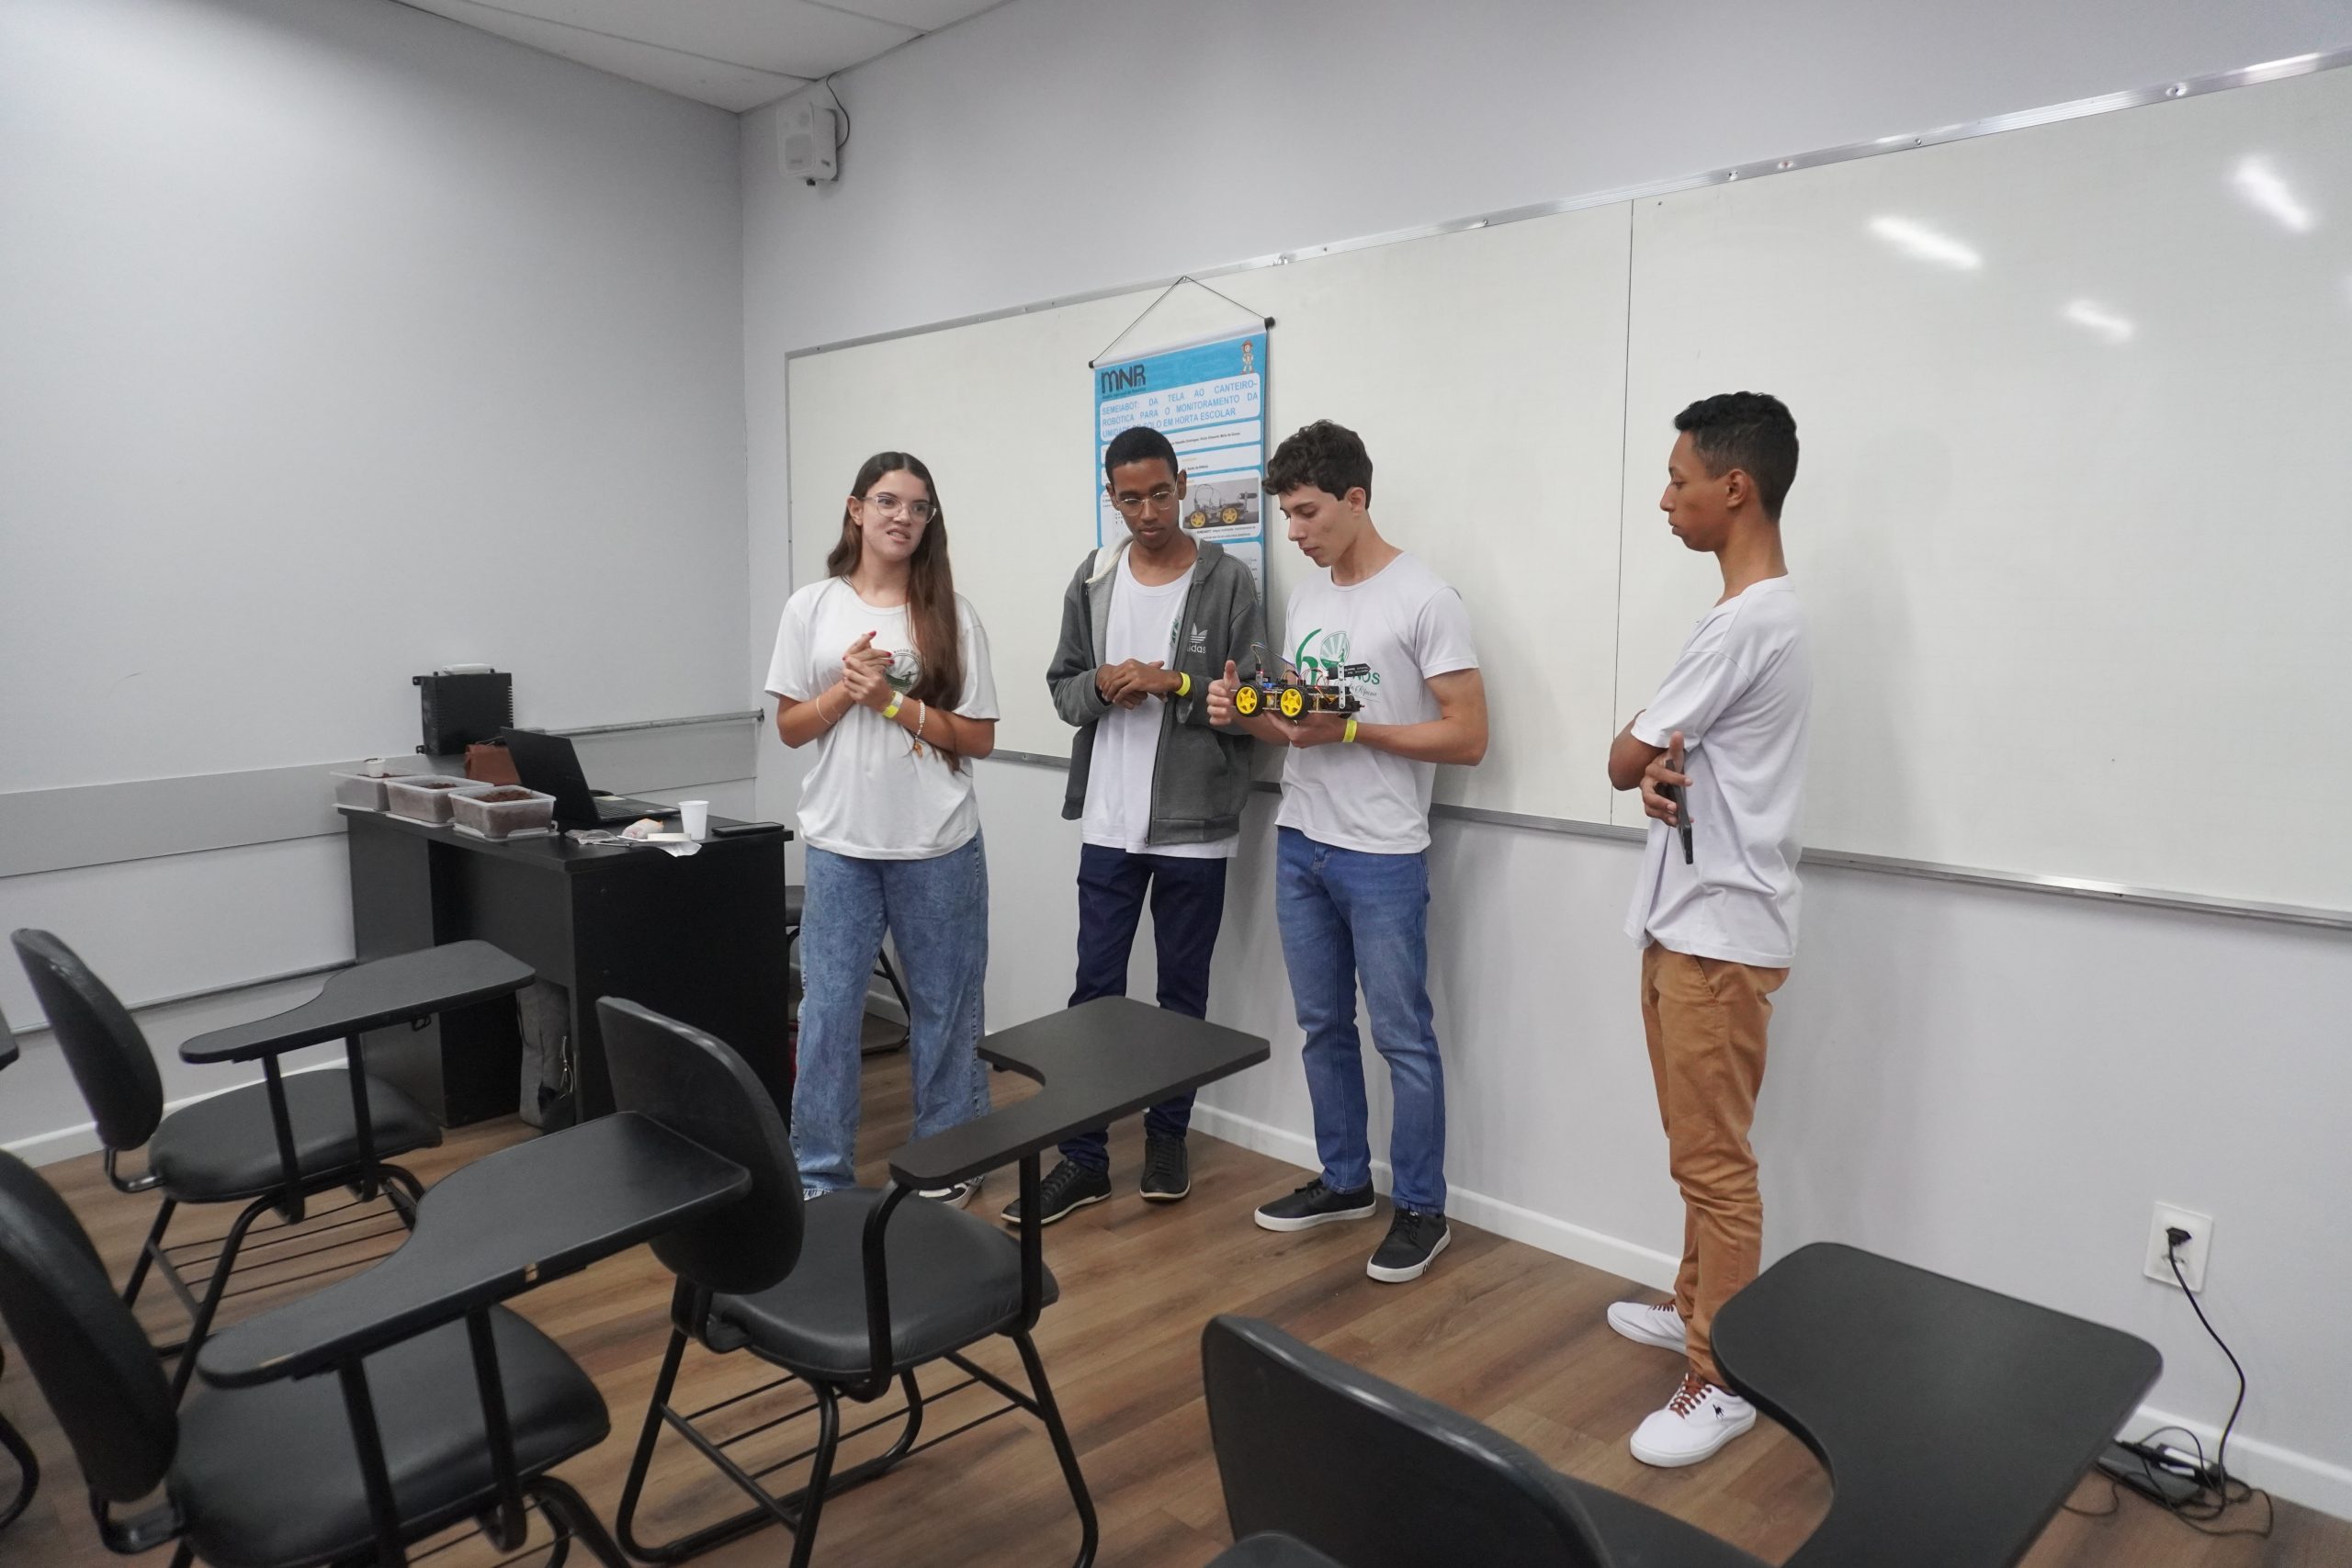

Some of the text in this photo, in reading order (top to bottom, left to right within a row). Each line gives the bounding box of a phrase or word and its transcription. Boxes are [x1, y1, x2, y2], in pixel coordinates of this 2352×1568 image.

[1148, 397, 1159, 406] DA
[1168, 392, 1185, 403] TELA
[1193, 388, 1204, 398] AO
[1214, 379, 1258, 394] CANTEIRO-
[1102, 413, 1135, 427] ROBÓTICA
[1139, 410, 1159, 420] PARA
[1164, 407, 1171, 416] O
[1175, 394, 1240, 412] MONITORAMENTO
[1247, 391, 1259, 401] DA
[1162, 418, 1174, 427] EM
[1174, 413, 1199, 425] HORTA
[1200, 408, 1237, 421] ESCOLAR
